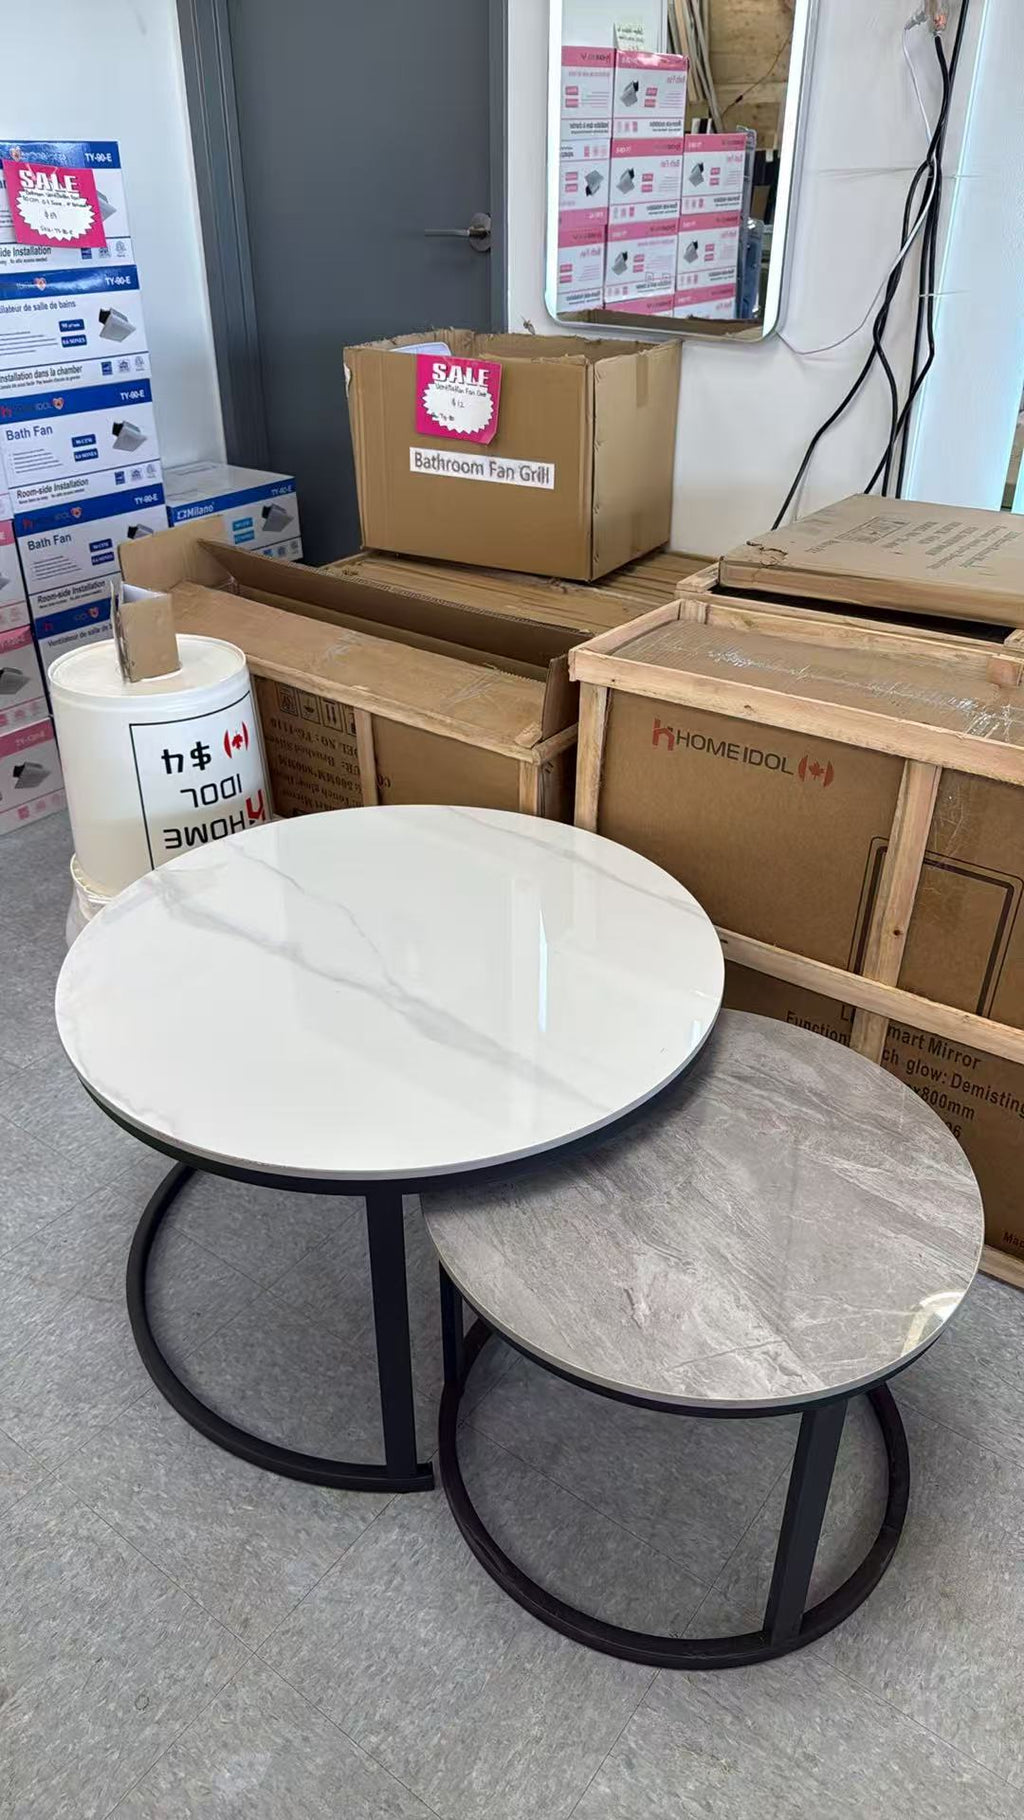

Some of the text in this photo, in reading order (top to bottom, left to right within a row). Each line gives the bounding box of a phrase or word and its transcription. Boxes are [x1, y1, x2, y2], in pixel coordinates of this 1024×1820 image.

[19, 169, 80, 193] SALE
[12, 247, 52, 256] Installation
[50, 301, 57, 309] de
[59, 300, 76, 308] bains
[0, 371, 33, 382] nstallation
[34, 369, 49, 378] dans
[50, 368, 56, 376] la
[57, 365, 83, 375] chamber
[432, 362, 489, 387] SALE
[6, 425, 53, 441] Bath Fan
[414, 452, 549, 484] Bathroom Fan Grill
[16, 482, 52, 498] Room-side
[53, 477, 89, 491] Installation
[187, 505, 214, 517] Milano
[27, 533, 72, 551] Bath Fan
[37, 589, 71, 604] Room-side
[72, 580, 105, 594] Installation
[180, 773, 242, 808] IDOL
[163, 811, 246, 849] HOME
[887, 1026, 926, 1050] mart
[928, 1037, 981, 1070] Mirror
